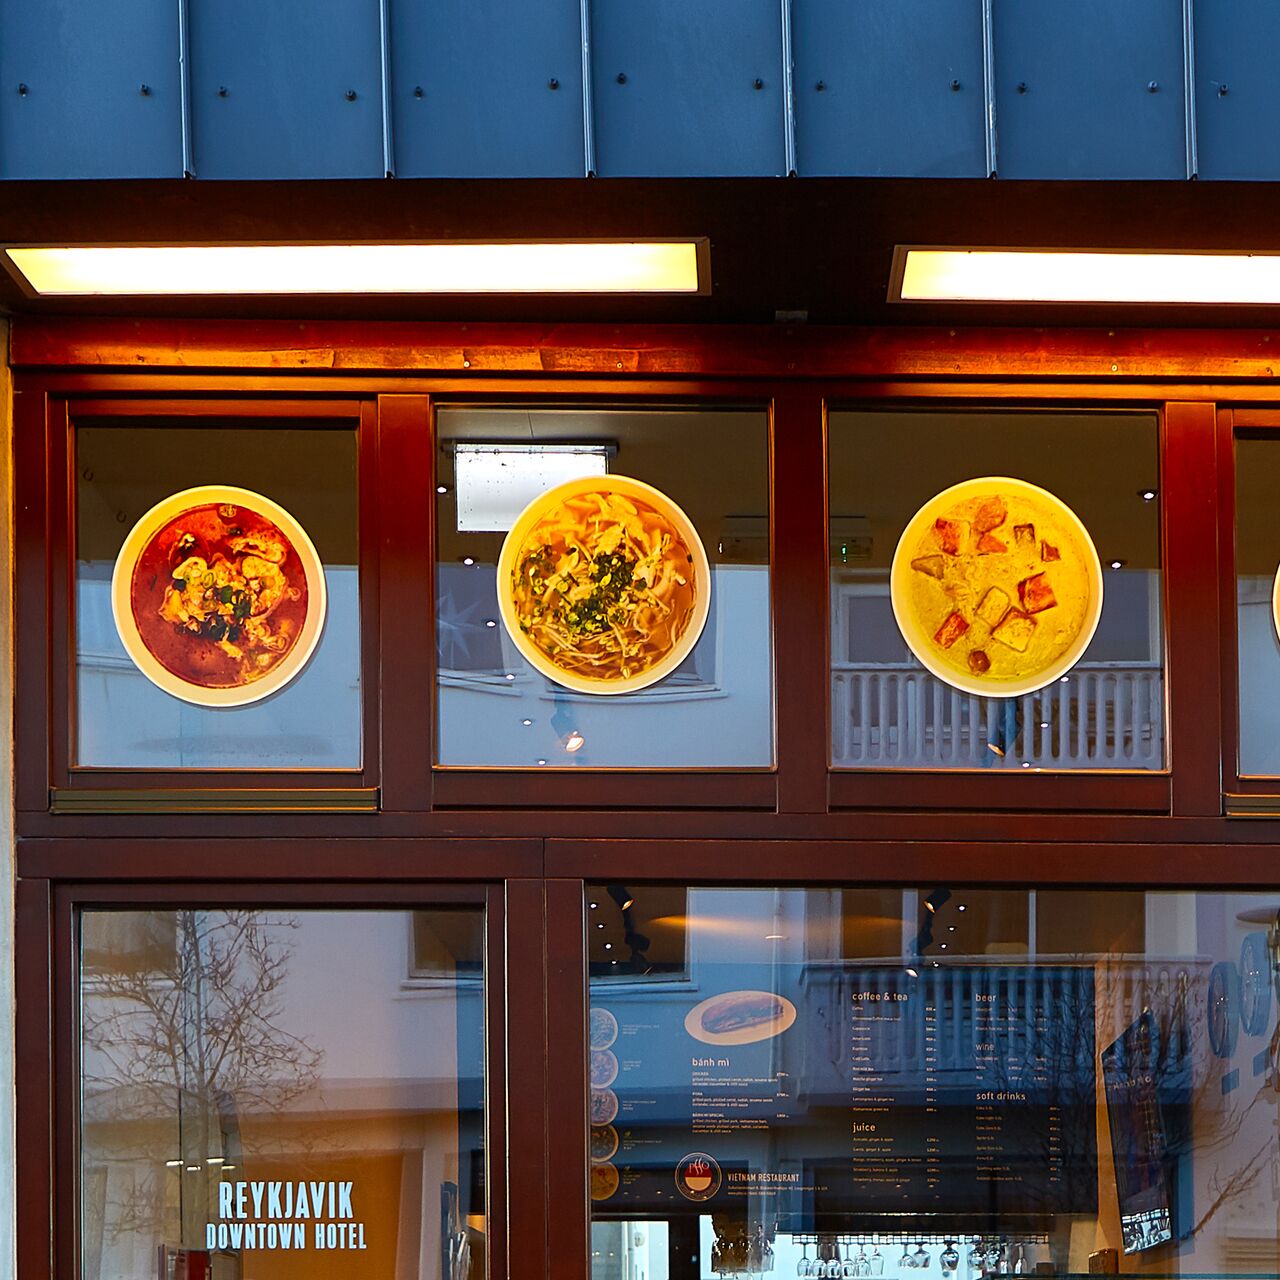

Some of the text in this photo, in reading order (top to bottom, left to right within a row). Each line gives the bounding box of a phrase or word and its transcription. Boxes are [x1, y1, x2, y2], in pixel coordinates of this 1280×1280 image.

[852, 991, 881, 1001] coffee
[893, 992, 909, 1001] tea
[975, 993, 997, 1003] beer
[975, 1042, 995, 1051] wine
[976, 1091, 1027, 1101] soft drinks
[852, 1122, 877, 1134] juice
[728, 1173, 800, 1182] VIETNAM RESTAURANT
[219, 1181, 354, 1219] REYKJAVIK
[206, 1223, 368, 1249] DOWNTOWN HOTEL
